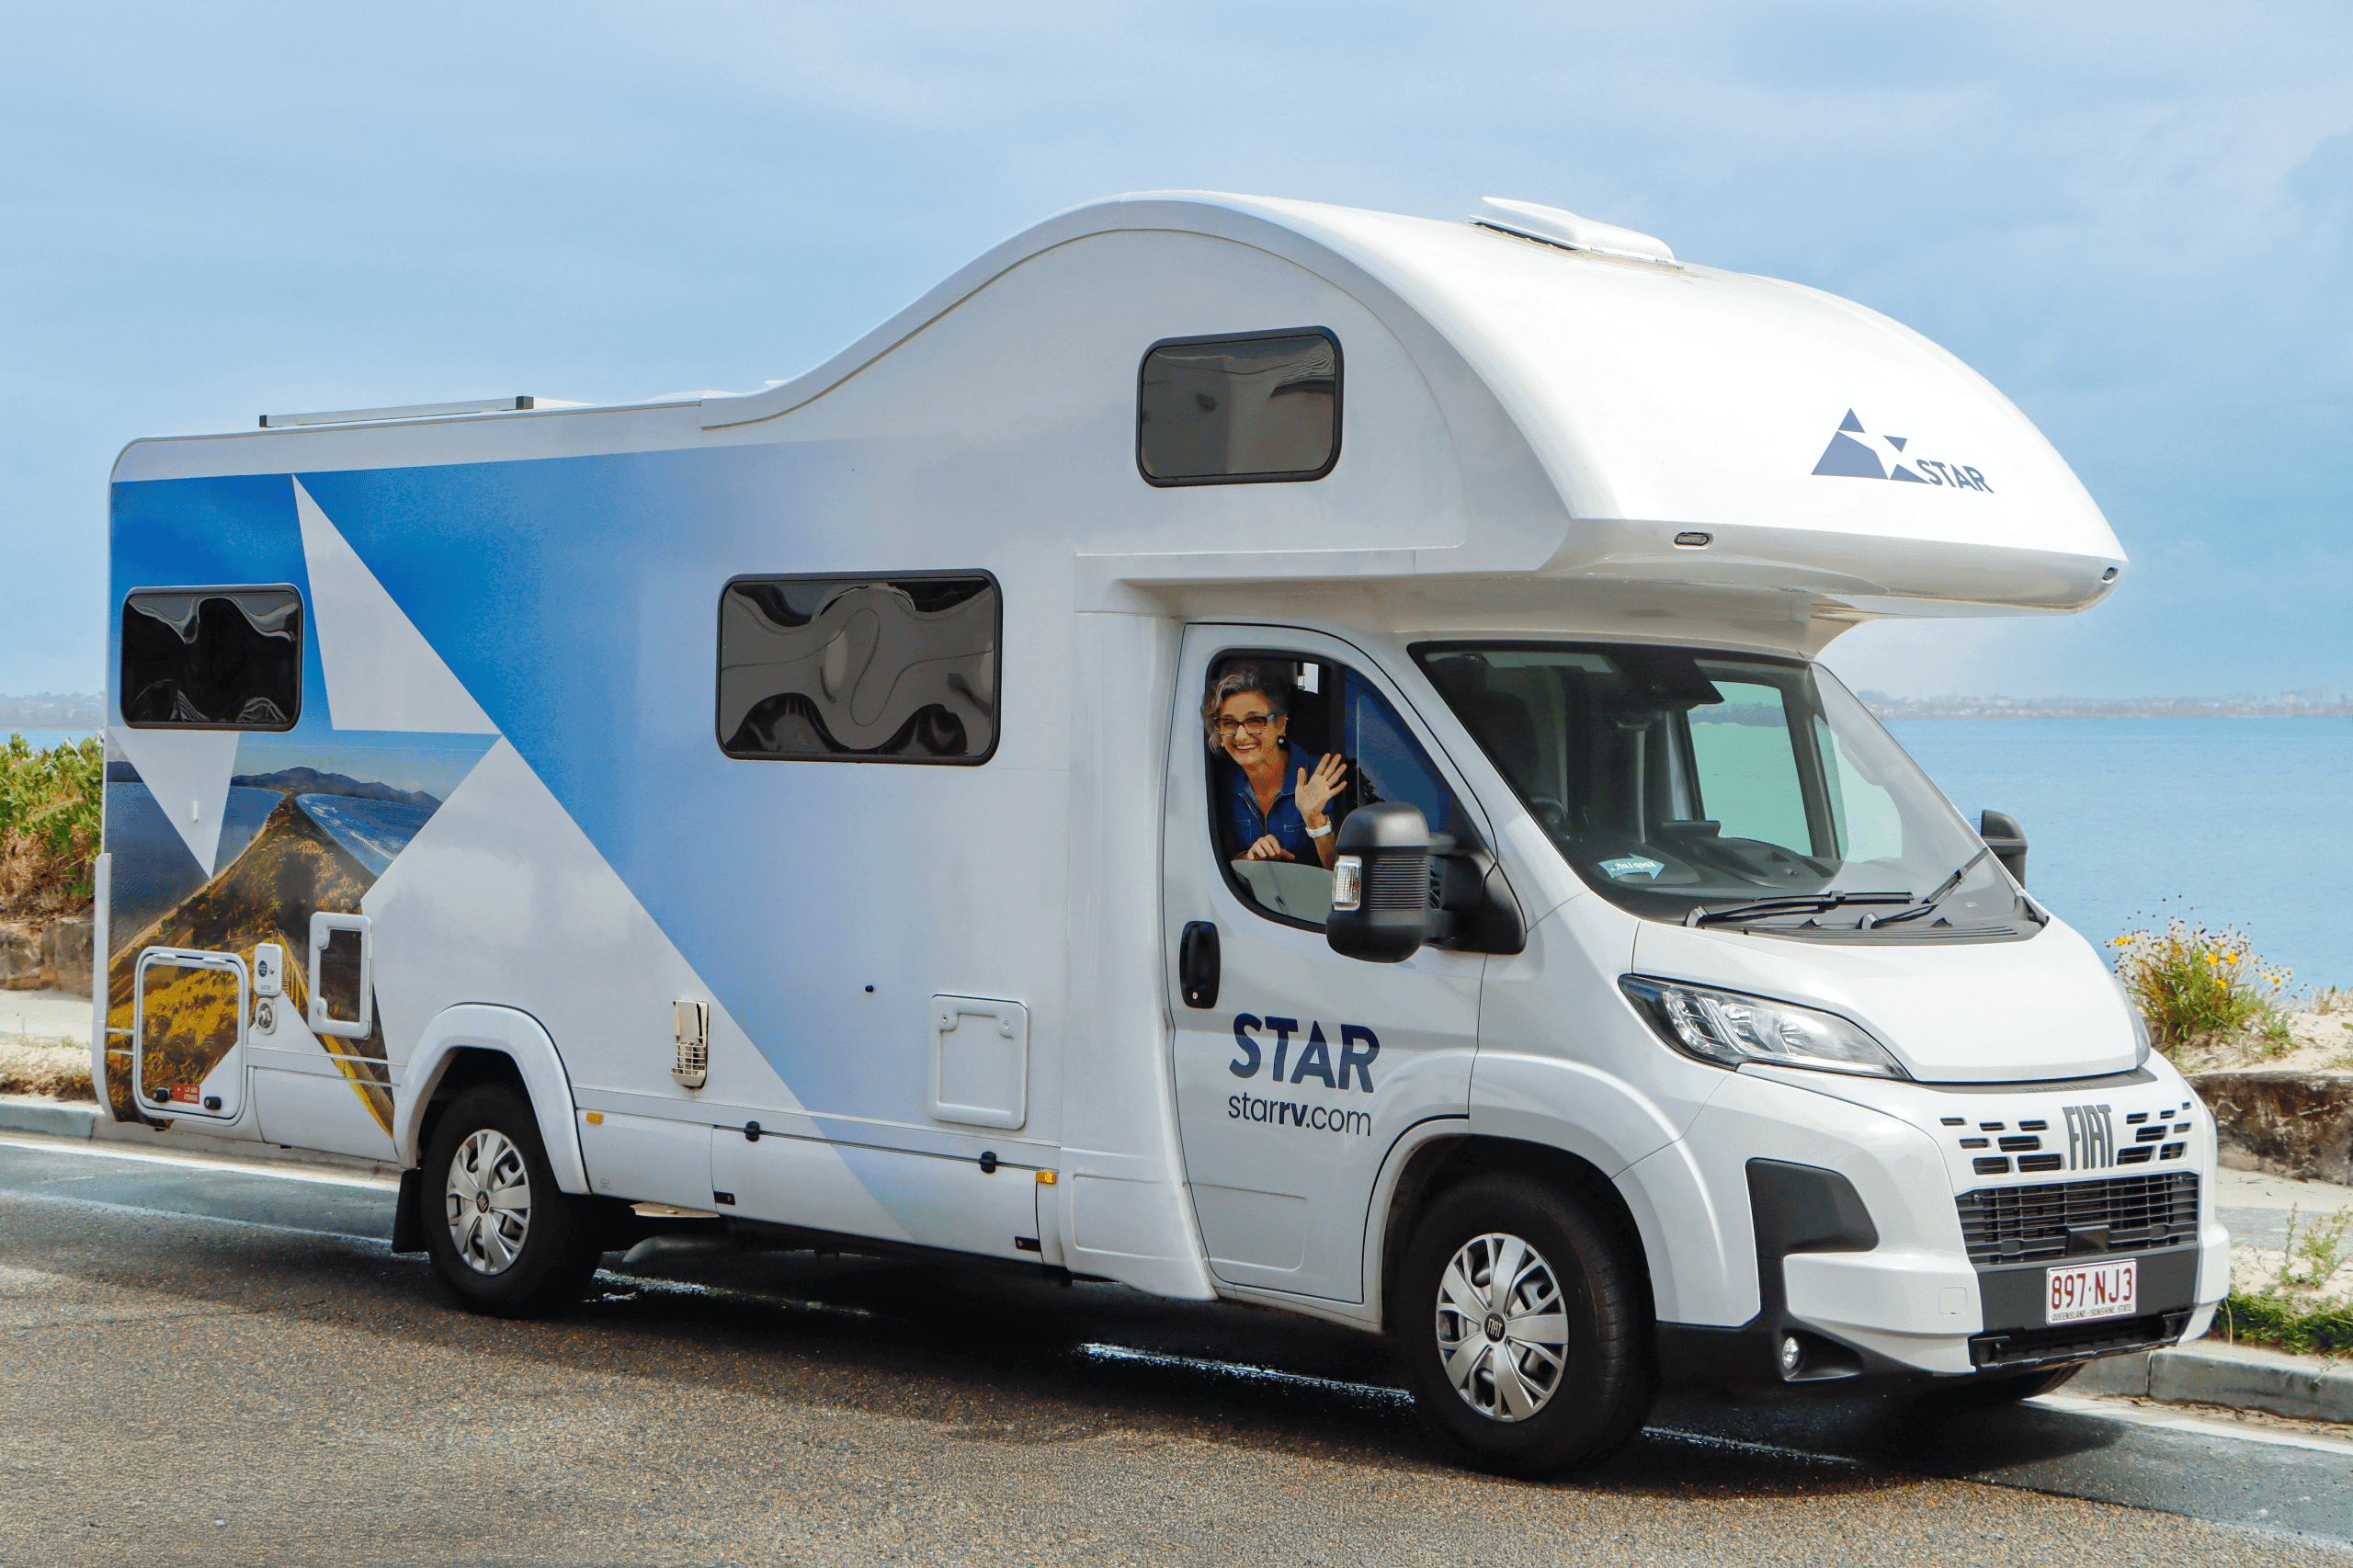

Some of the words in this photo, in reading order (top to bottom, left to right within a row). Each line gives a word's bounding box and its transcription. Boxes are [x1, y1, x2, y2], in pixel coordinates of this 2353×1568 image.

[1915, 459, 1995, 494] STAR
[1229, 1012, 1381, 1093] STAR
[1228, 1092, 1371, 1137] starrv.com
[2062, 1104, 2114, 1170] FIAT
[1486, 1318, 1503, 1338] FIAT
[2052, 1310, 2086, 1321] QUEENSLAND
[2090, 1306, 2115, 1316] SUNSHINE
[2118, 1303, 2132, 1312] STATE
